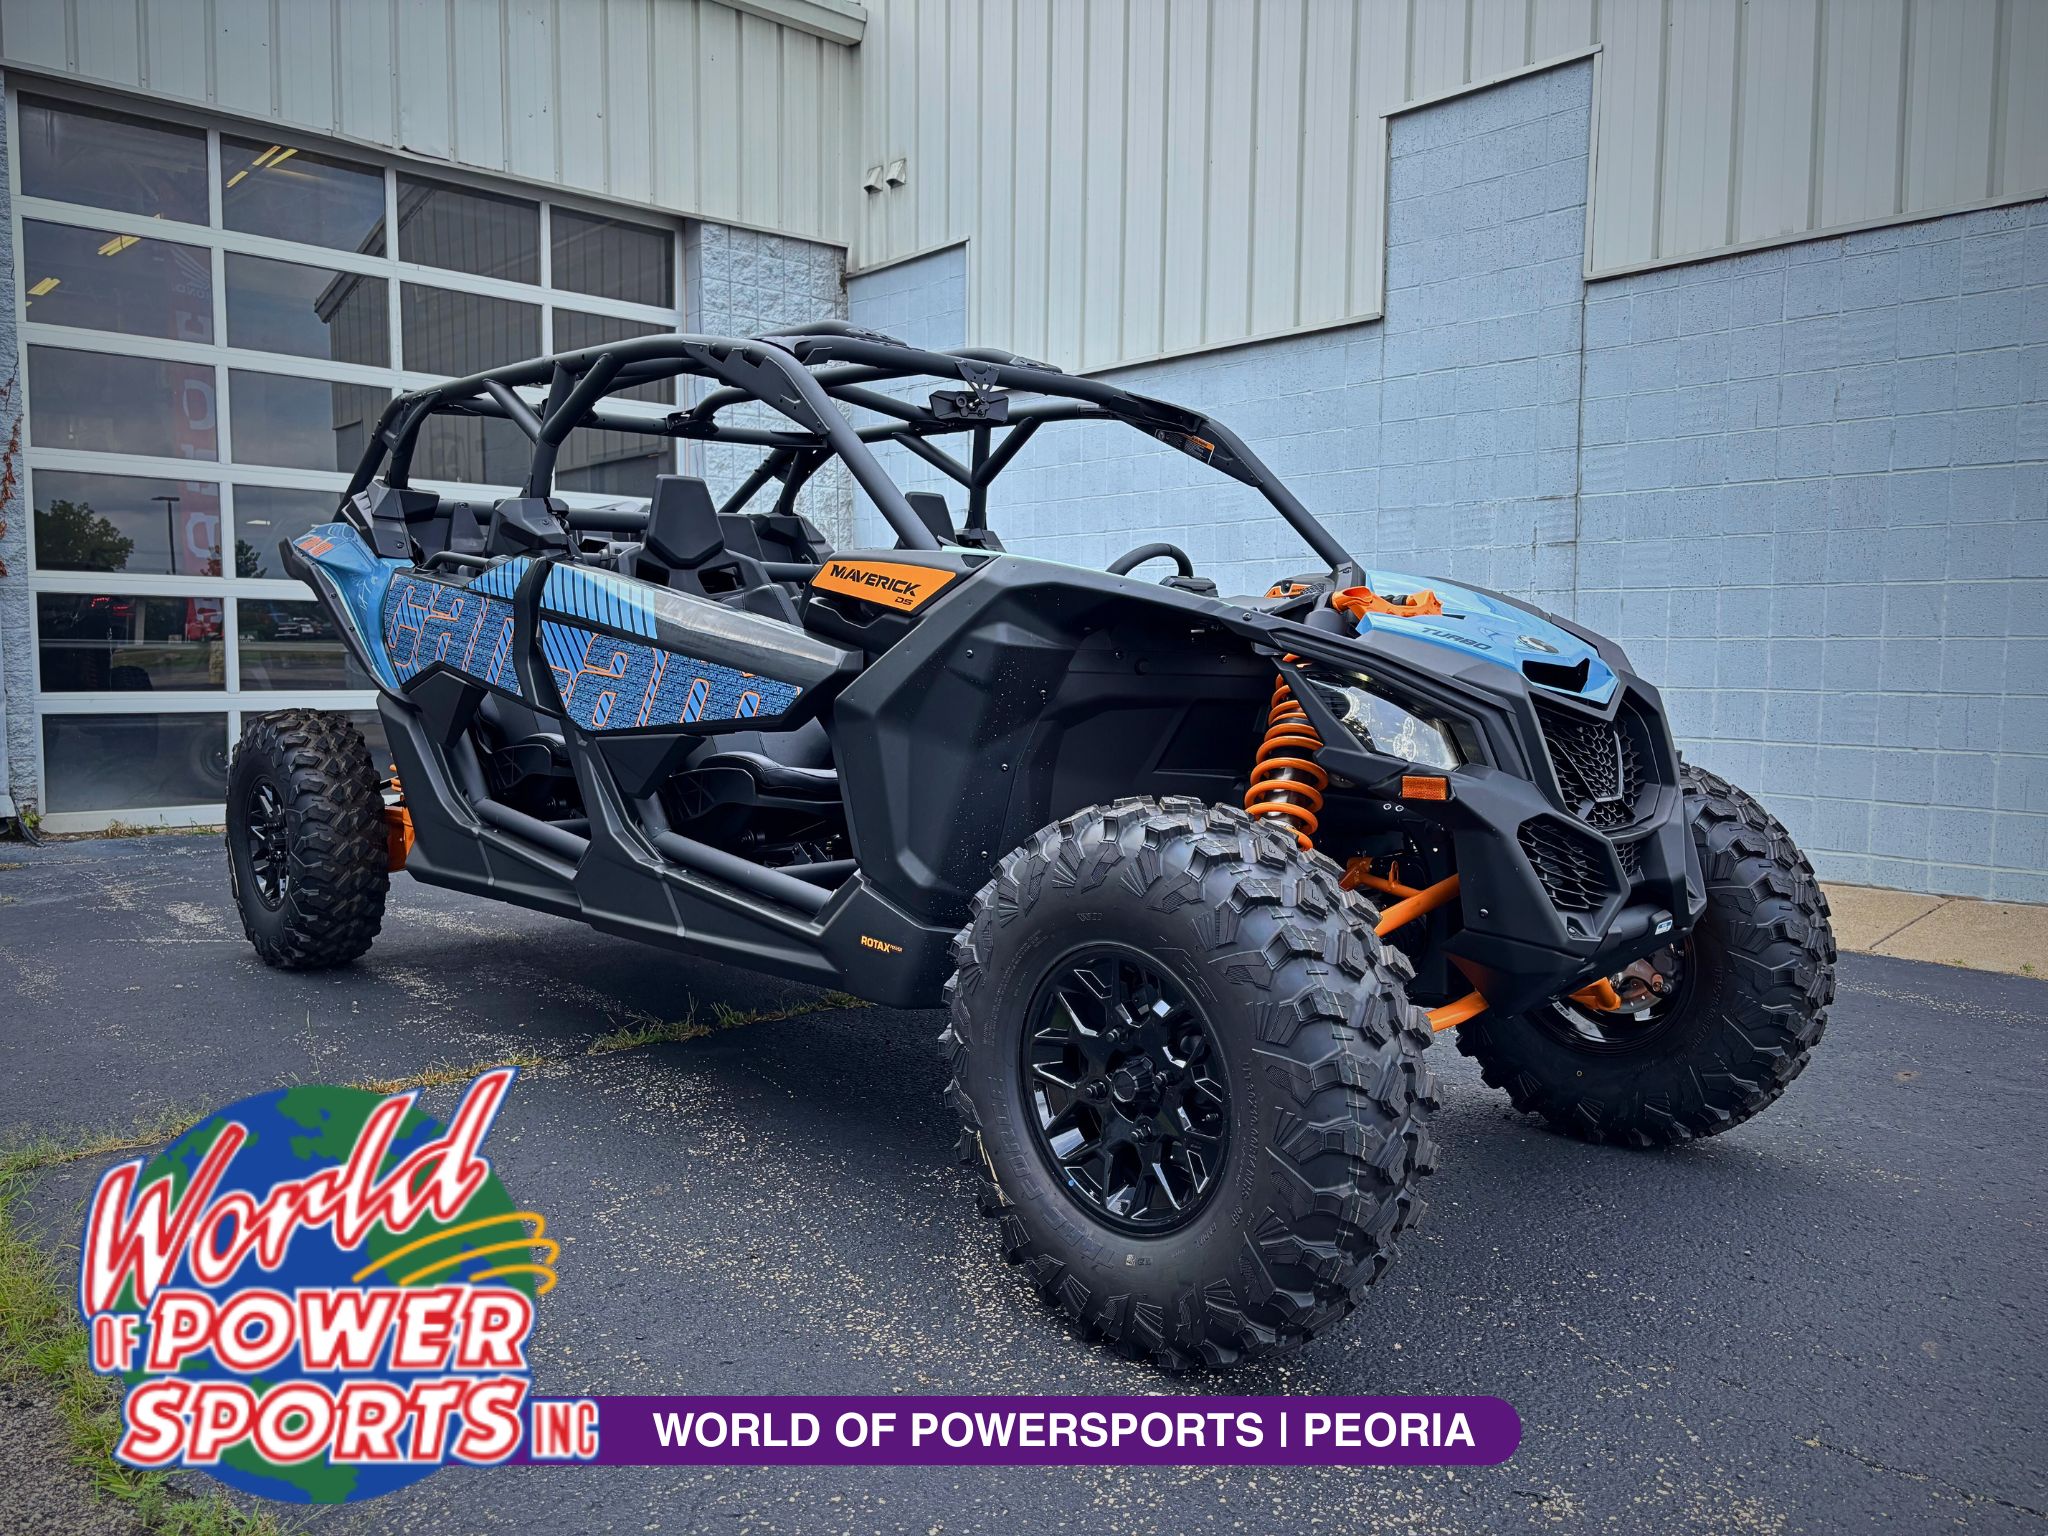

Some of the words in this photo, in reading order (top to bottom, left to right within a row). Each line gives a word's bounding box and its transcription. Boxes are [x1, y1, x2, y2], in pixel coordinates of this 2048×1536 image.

[830, 564, 921, 597] MAVERICK
[894, 596, 914, 606] DS
[1422, 627, 1493, 651] TURBO
[860, 935, 891, 953] ROTAX
